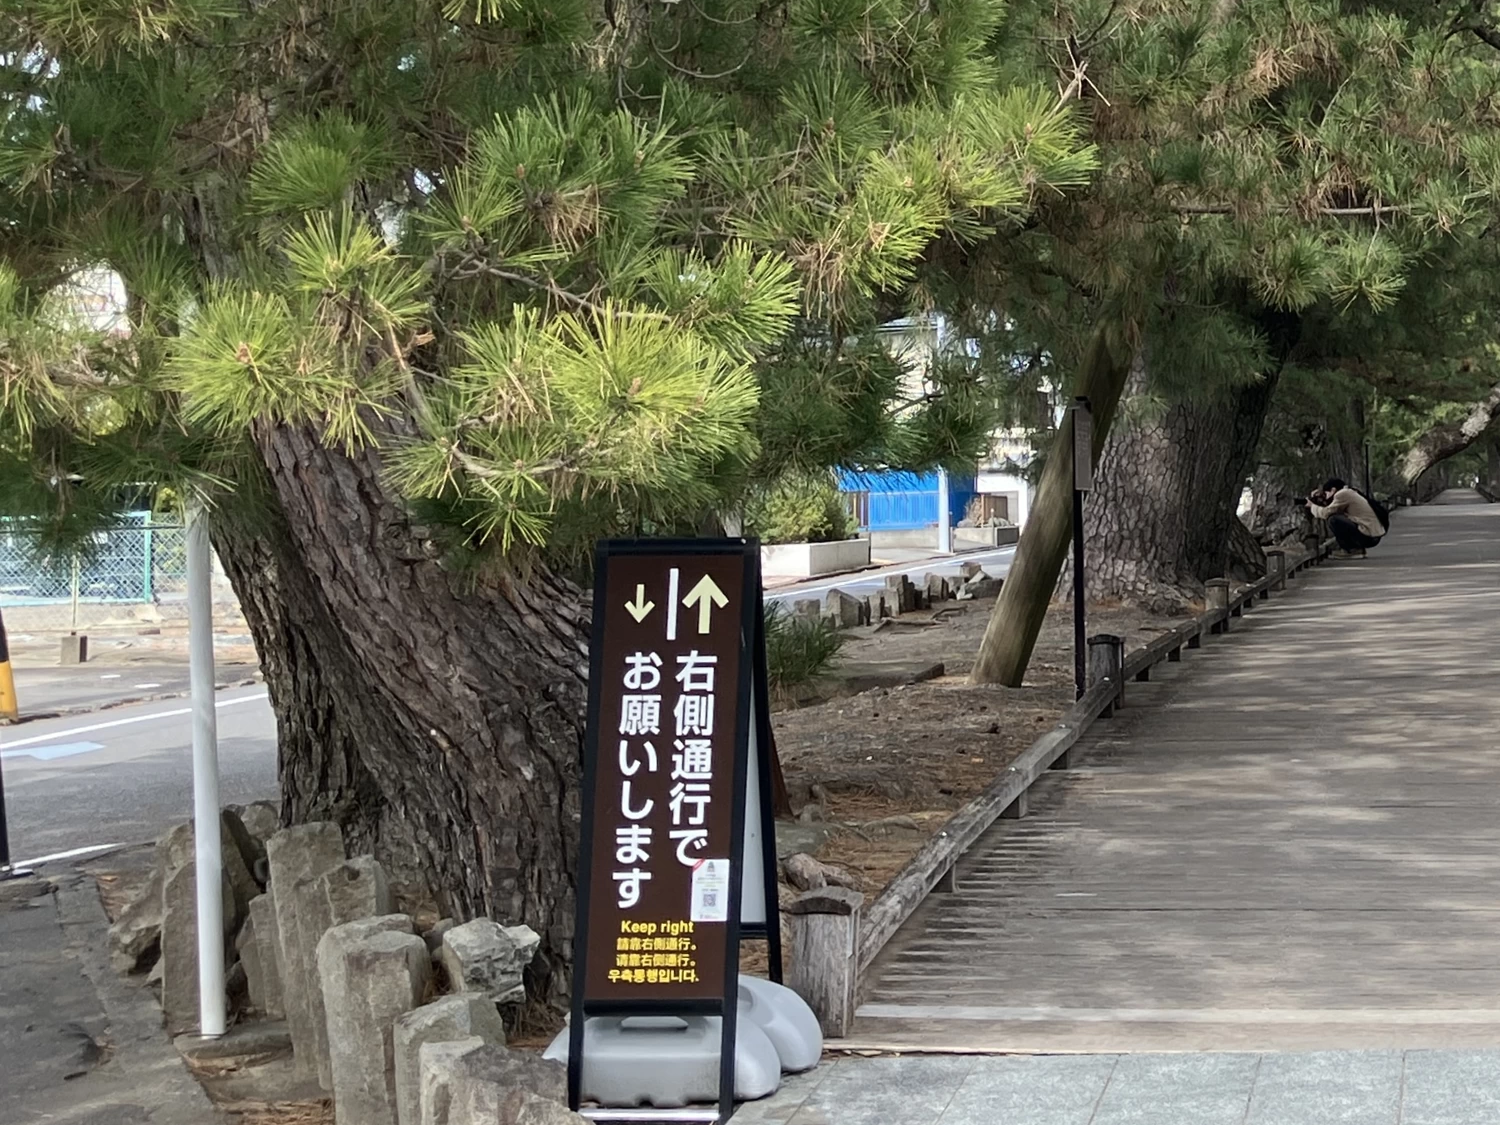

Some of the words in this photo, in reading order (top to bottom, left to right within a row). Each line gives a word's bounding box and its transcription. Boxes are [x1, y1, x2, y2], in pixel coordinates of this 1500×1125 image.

[612, 651, 663, 909] お願いします
[668, 650, 718, 867] 右側通行で
[621, 920, 657, 936] Keep
[660, 920, 694, 936] right
